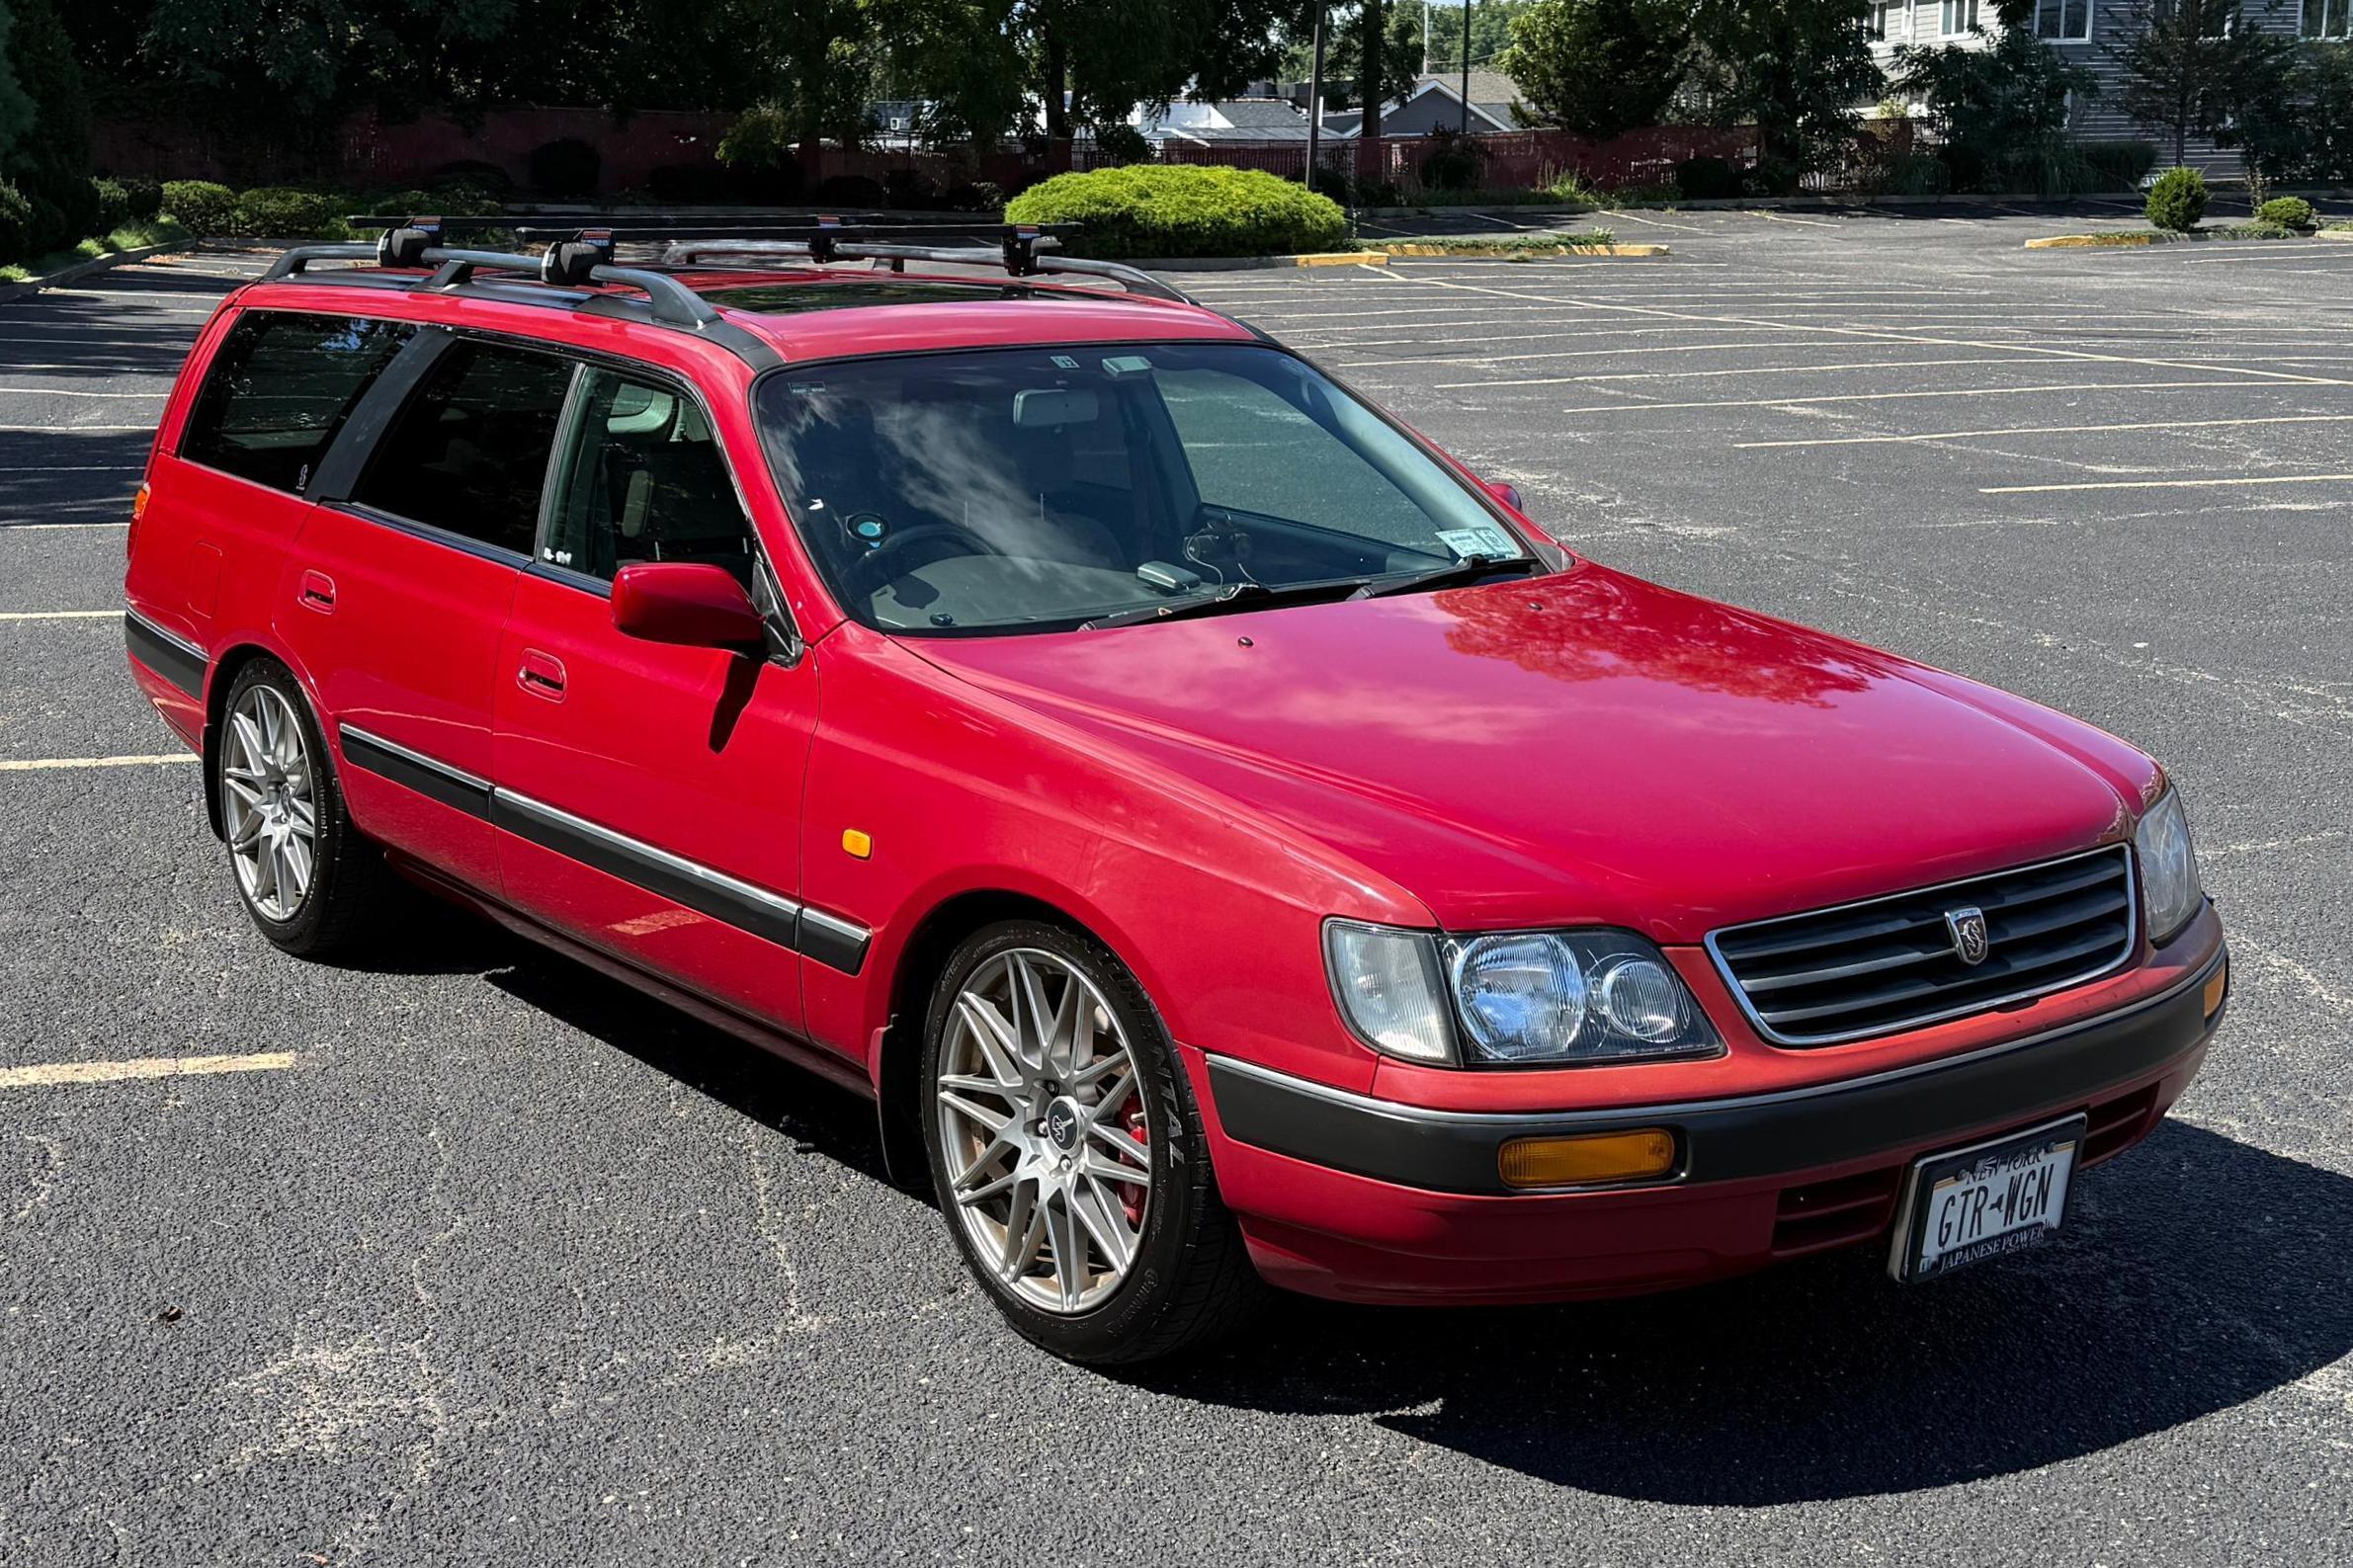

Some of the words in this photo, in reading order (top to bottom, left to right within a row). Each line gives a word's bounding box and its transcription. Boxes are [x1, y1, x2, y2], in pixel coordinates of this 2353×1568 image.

[1937, 1185, 1988, 1249] GTR
[2002, 1163, 2055, 1227] WGN
[1939, 1240, 2000, 1274] JAPANESE
[2001, 1225, 2046, 1252] POWER
